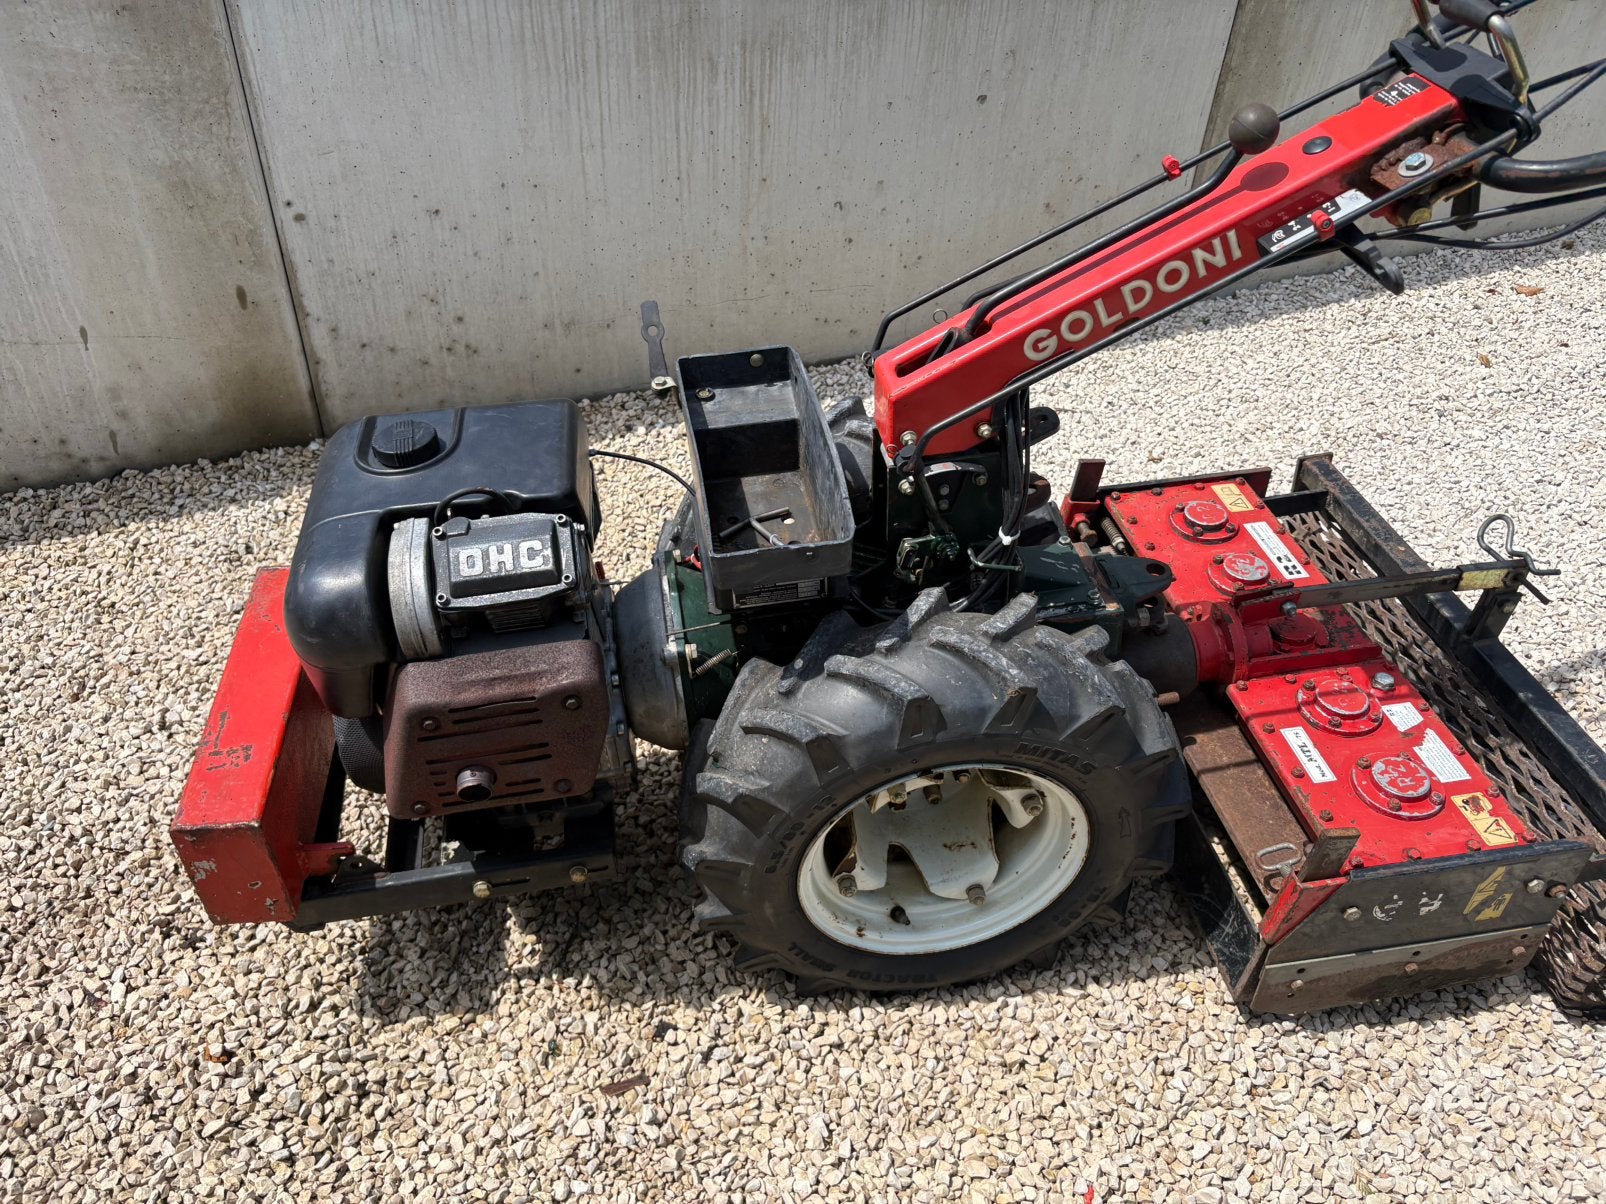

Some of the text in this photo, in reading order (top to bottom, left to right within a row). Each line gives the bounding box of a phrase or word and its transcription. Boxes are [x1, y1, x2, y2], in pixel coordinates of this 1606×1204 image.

[1023, 229, 1242, 361] GOLDONI
[458, 539, 544, 577] OHC
[1013, 741, 1098, 775] MITAS
